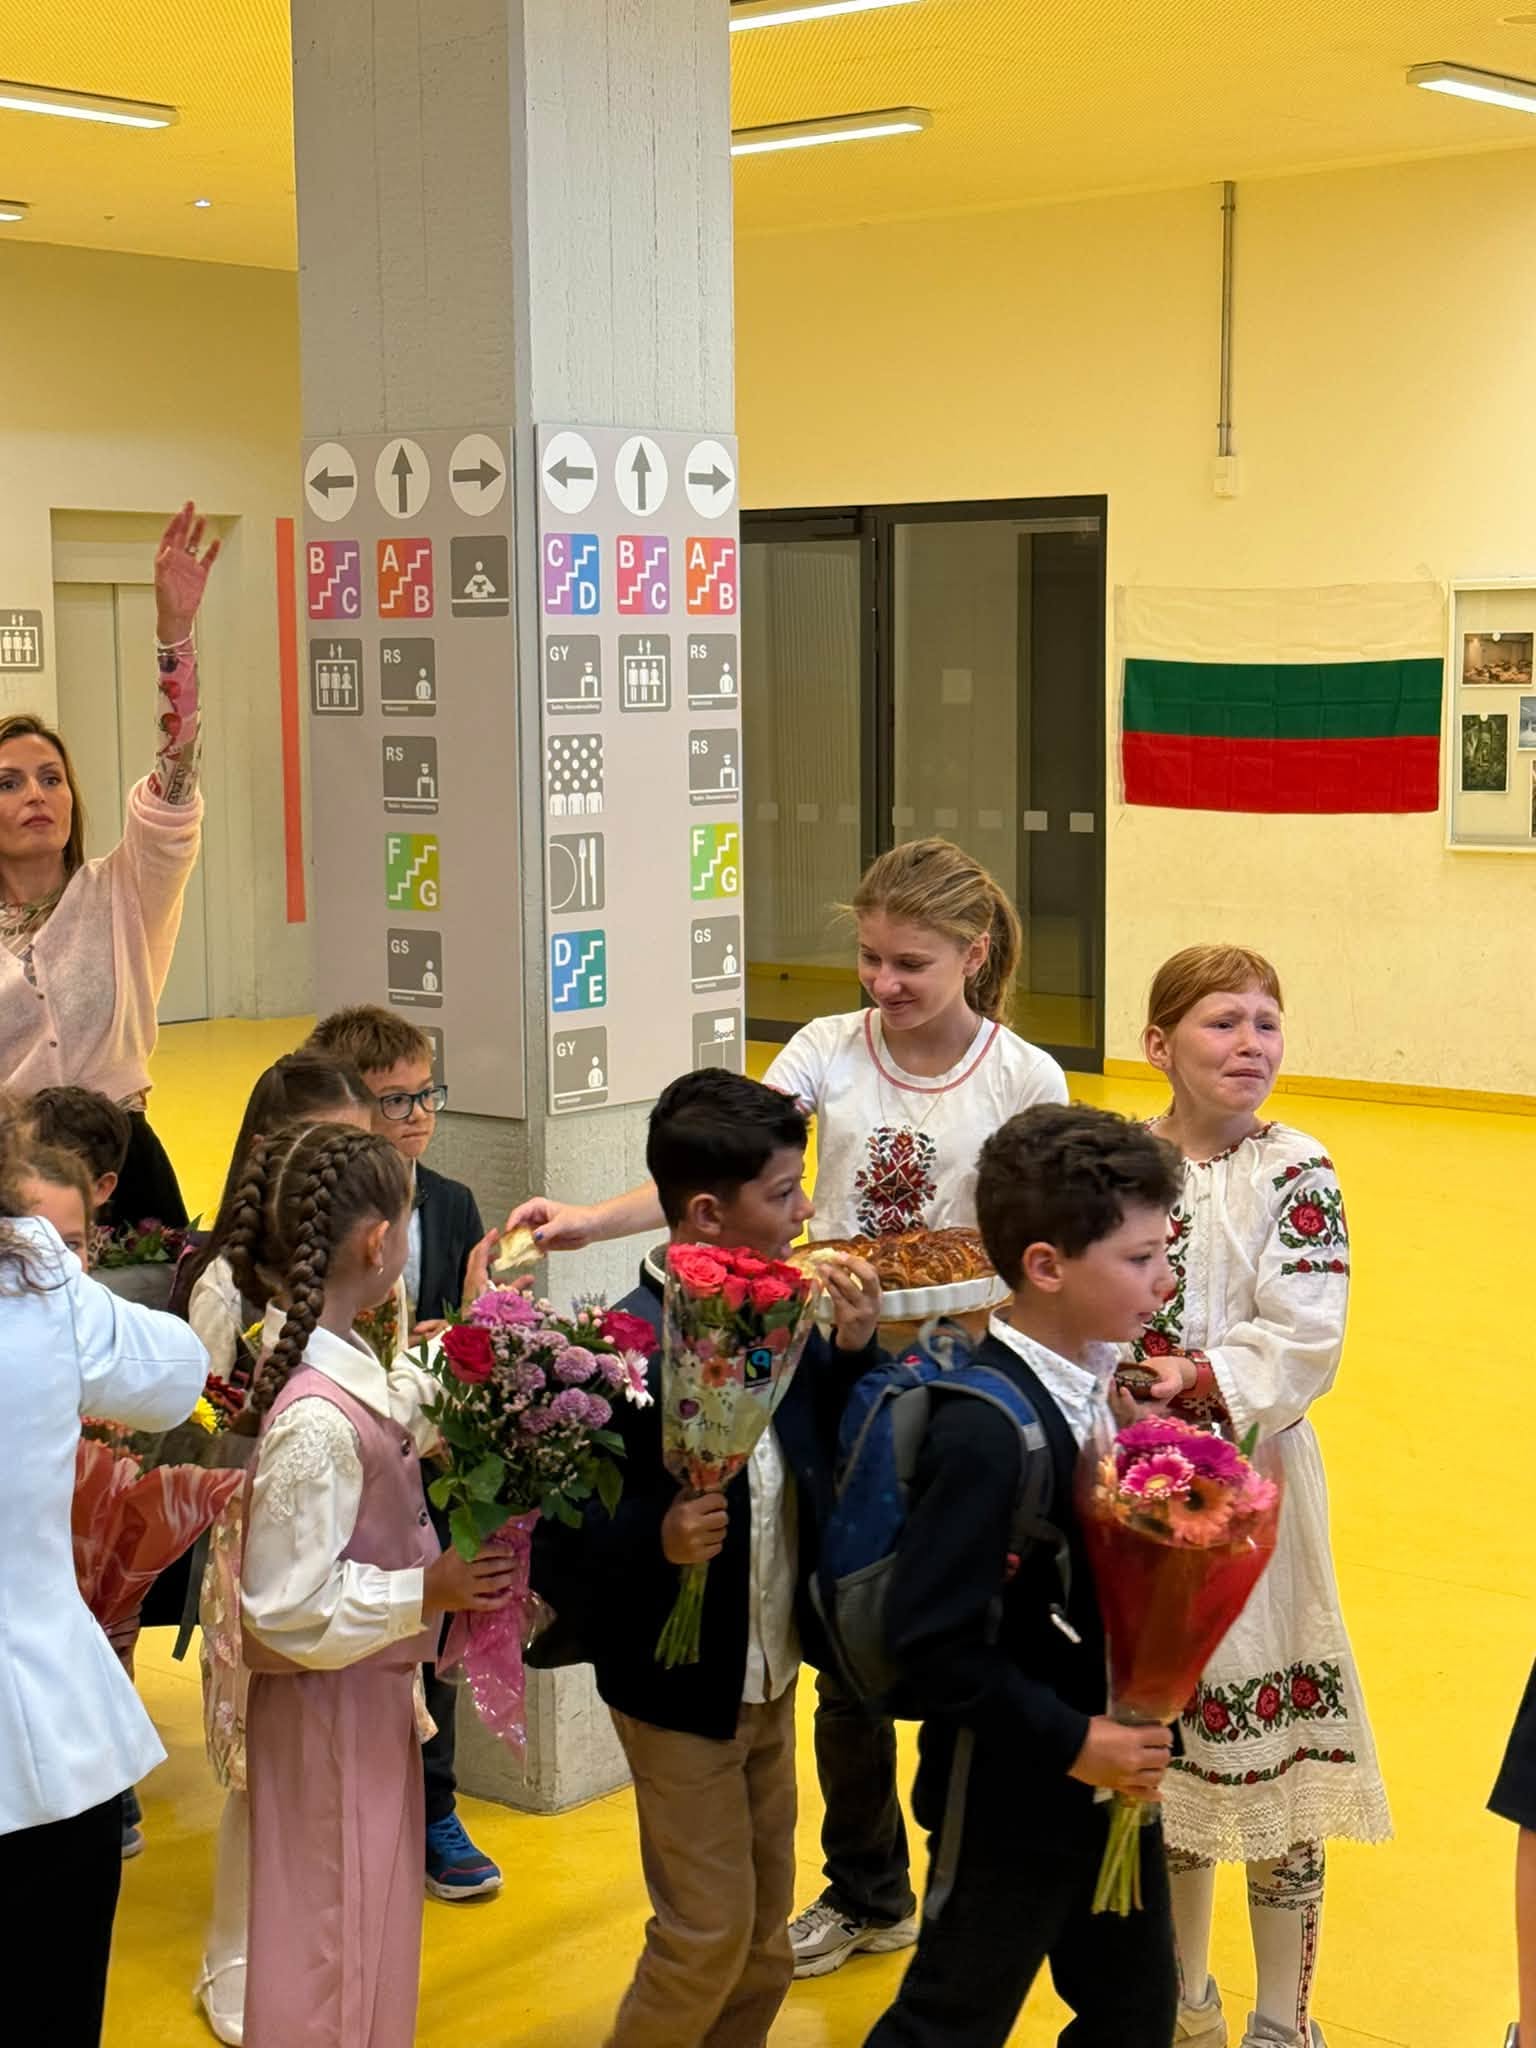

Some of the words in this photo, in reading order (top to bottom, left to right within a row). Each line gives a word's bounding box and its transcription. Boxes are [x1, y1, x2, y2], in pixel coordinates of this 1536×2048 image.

[310, 547, 325, 574] B
[382, 545, 399, 572] A
[548, 539, 563, 566] C
[620, 541, 634, 567] B
[690, 543, 706, 569] A
[342, 587, 357, 613] C
[414, 585, 430, 612] B
[580, 582, 596, 609] D
[651, 583, 666, 609] C
[720, 583, 733, 609] B
[383, 649, 401, 663] RS
[550, 646, 569, 661] GY
[690, 645, 707, 659] RS
[386, 747, 403, 761] RS
[691, 740, 708, 754] RS
[388, 838, 400, 864] F
[693, 830, 705, 856] F
[721, 867, 737, 892] G
[420, 880, 437, 906] G
[391, 940, 409, 954] GS
[694, 929, 711, 943] GS
[555, 939, 571, 966] D
[589, 976, 603, 1003] E
[557, 1041, 576, 1057] GY
